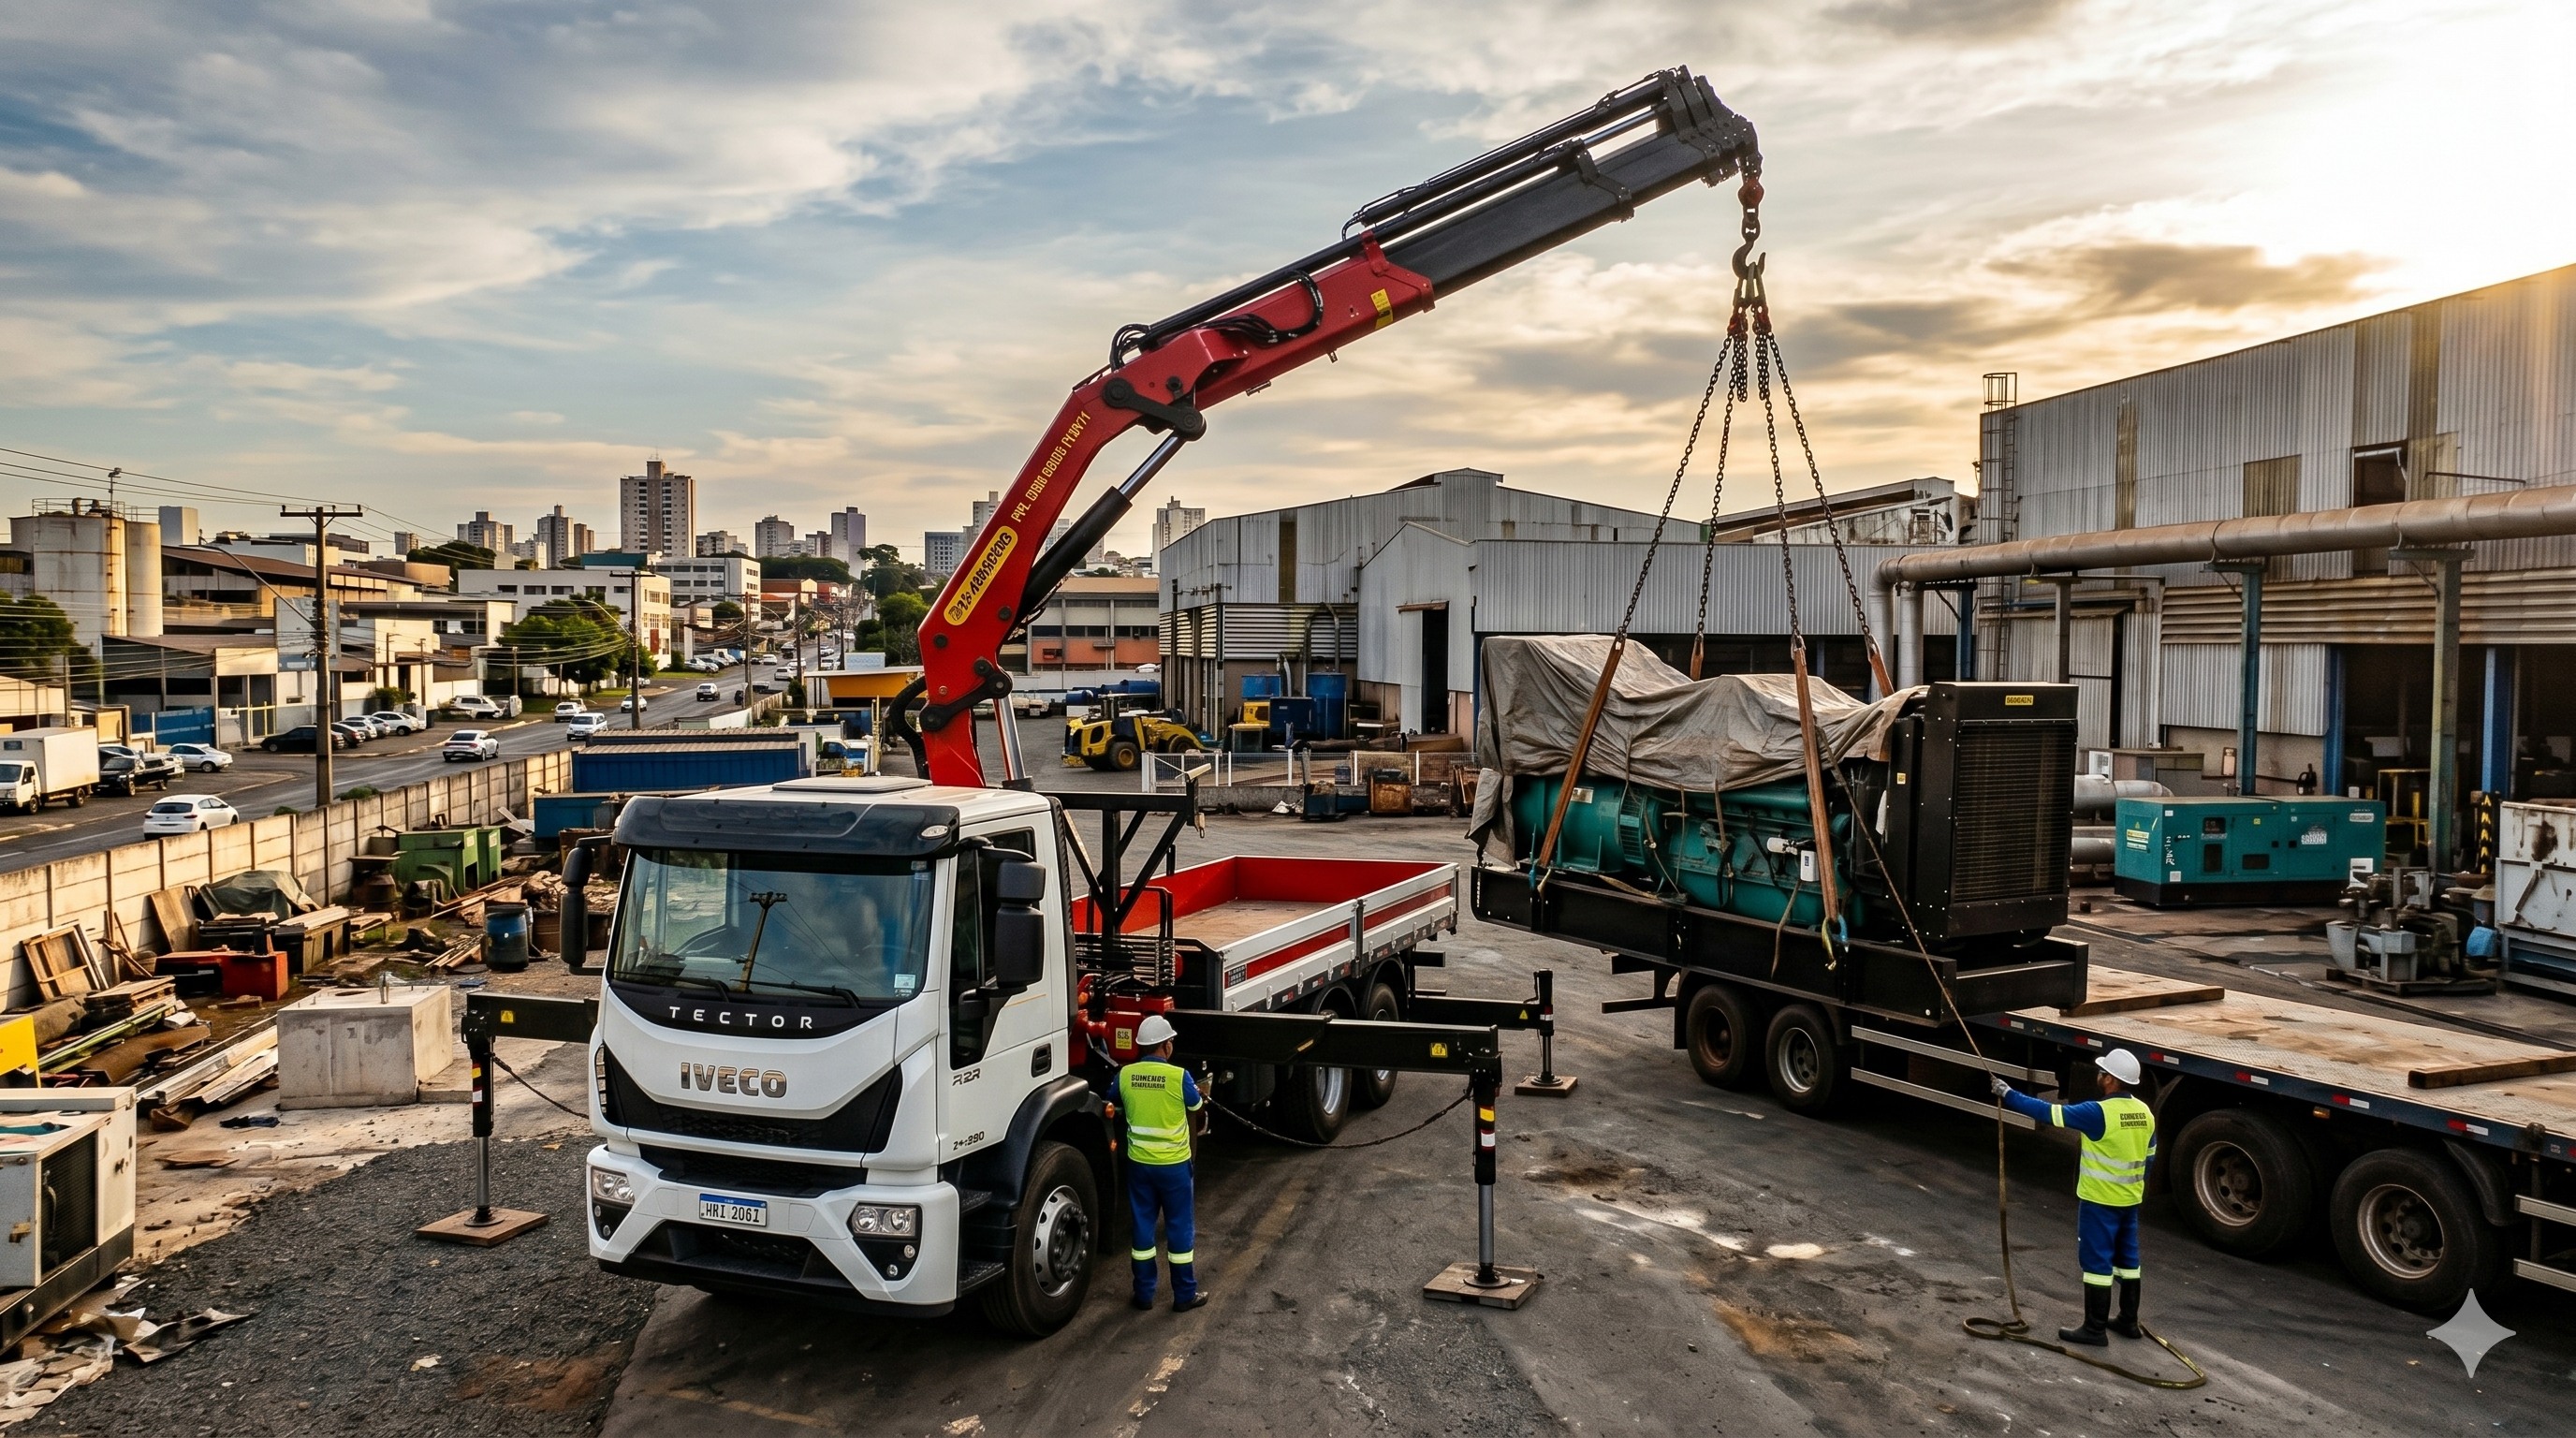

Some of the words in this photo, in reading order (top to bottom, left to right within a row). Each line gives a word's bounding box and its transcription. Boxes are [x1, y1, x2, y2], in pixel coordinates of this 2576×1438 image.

[668, 1005, 813, 1030] TECTOR
[681, 1062, 787, 1098] IVECO
[706, 1202, 726, 1219] HRI
[731, 1206, 760, 1223] 2061
